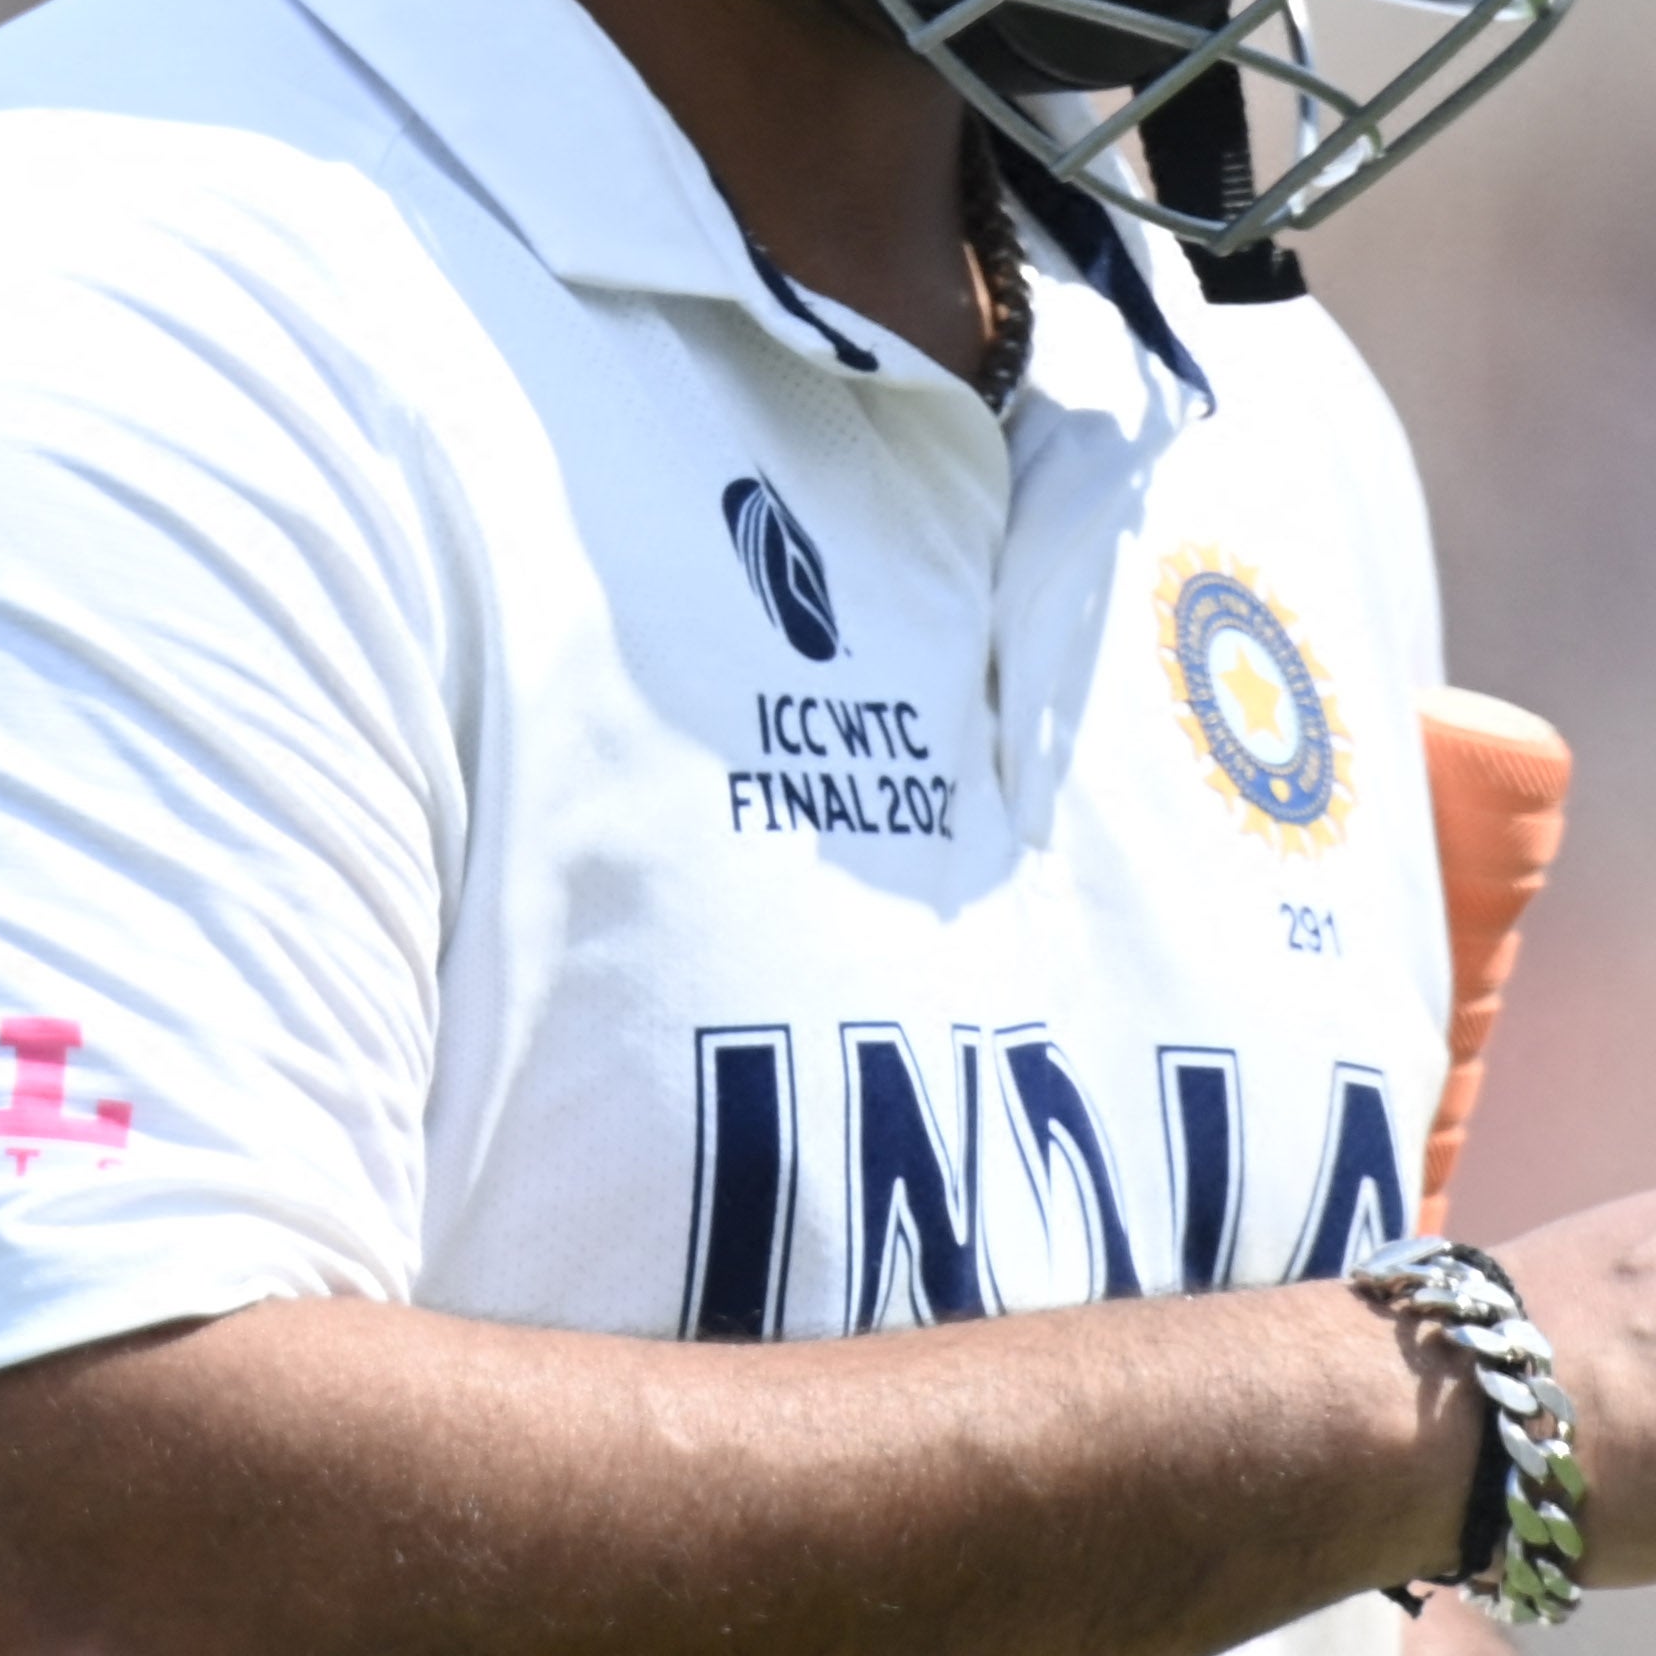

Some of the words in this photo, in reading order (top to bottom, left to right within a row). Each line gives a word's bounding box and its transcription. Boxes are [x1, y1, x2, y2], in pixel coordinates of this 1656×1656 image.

[757, 692, 828, 758] ICC
[826, 697, 930, 761] WTC
[728, 771, 880, 834] FINAL
[877, 774, 958, 842] 202
[1278, 901, 1343, 958] 291
